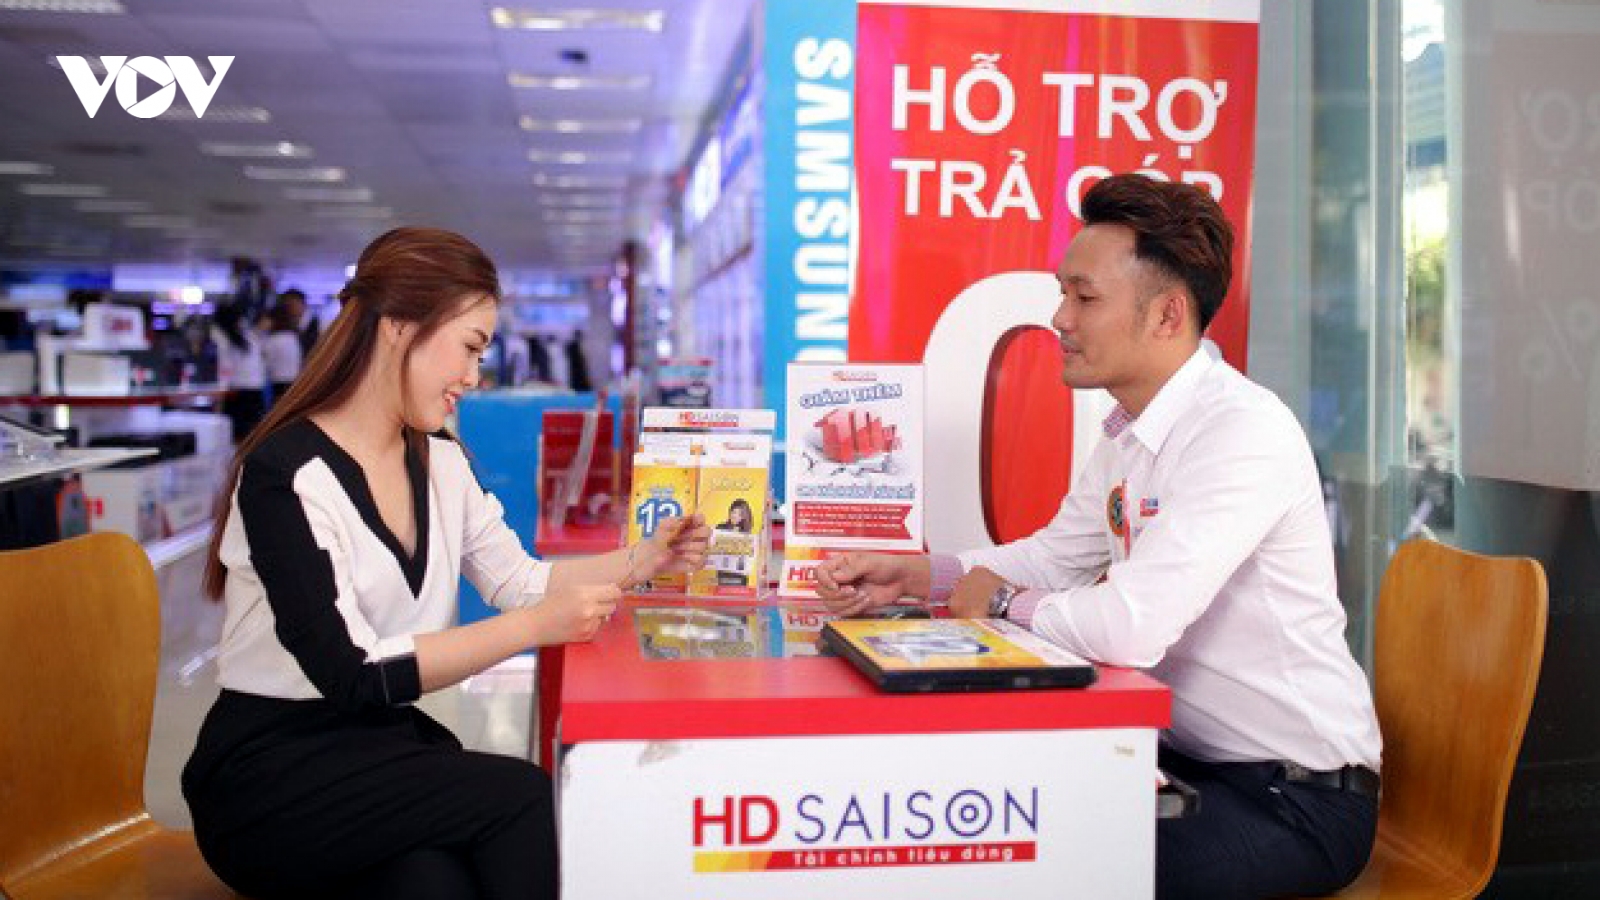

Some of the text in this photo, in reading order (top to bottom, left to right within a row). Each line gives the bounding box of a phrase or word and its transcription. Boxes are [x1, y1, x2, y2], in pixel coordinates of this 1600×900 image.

[892, 53, 1228, 159] HỖ TRỢ
[891, 149, 1043, 221] TRẢ
[693, 786, 1039, 847] HD SAISON
